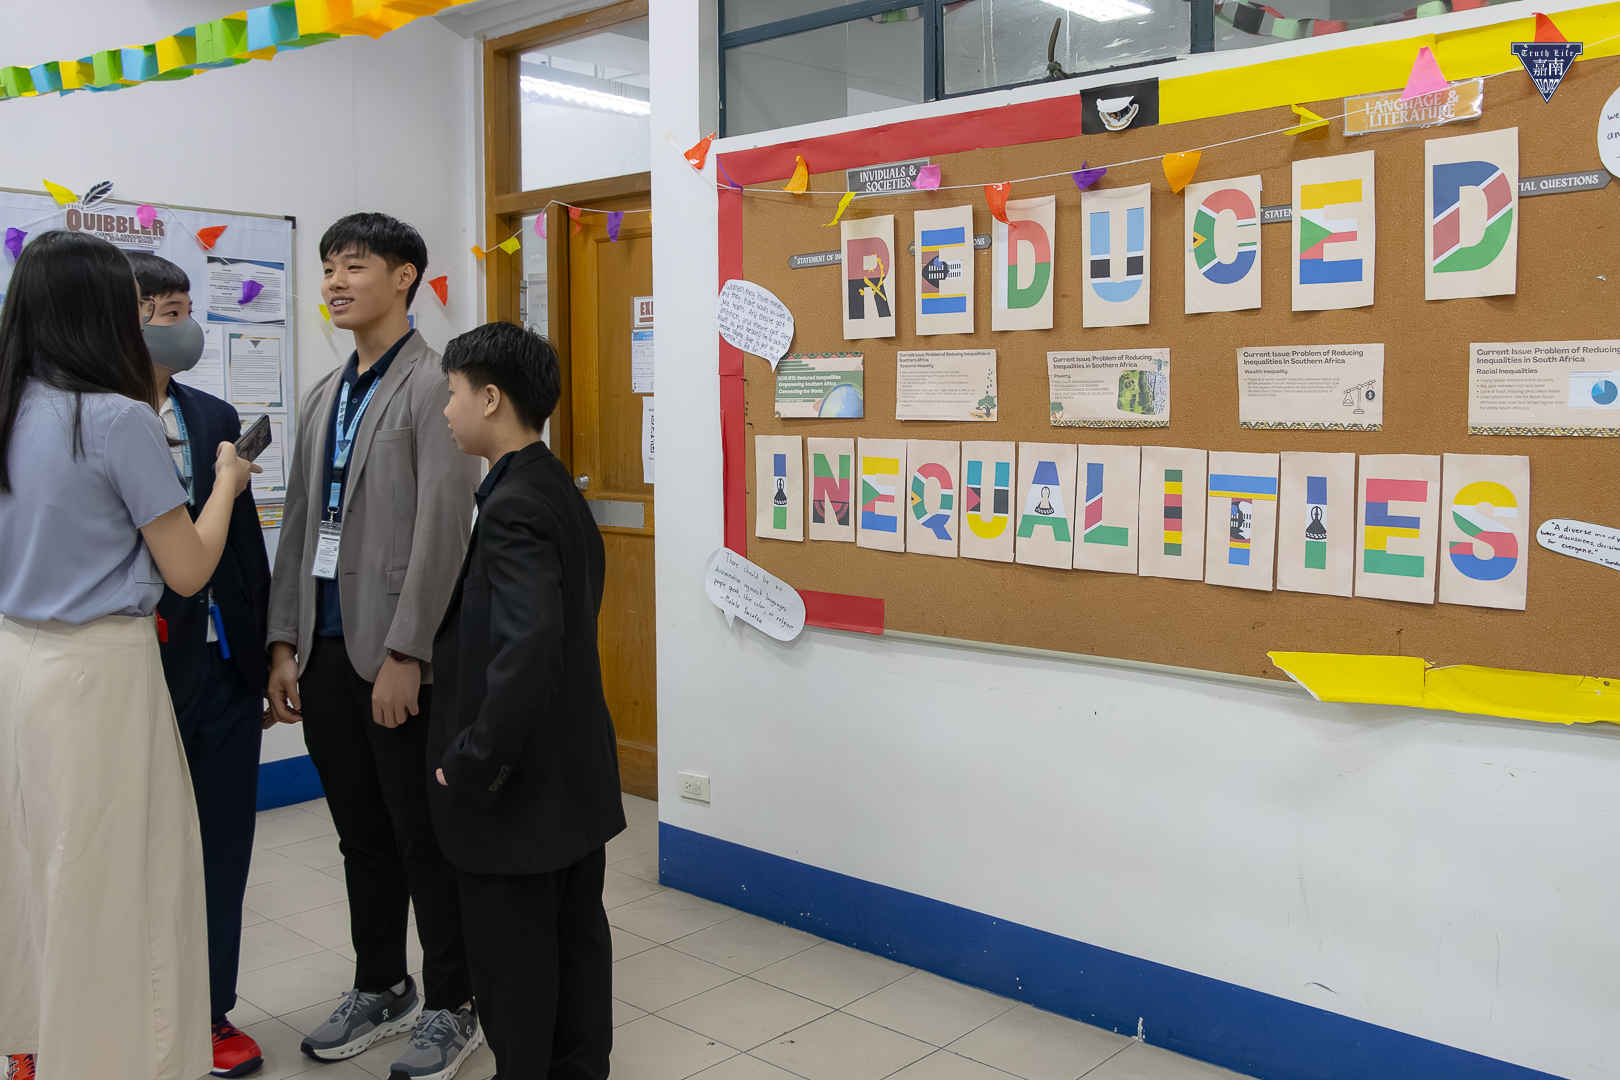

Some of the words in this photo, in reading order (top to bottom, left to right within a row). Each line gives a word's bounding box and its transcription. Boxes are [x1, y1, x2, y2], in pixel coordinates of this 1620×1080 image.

[1365, 92, 1442, 115] LANGUAGE
[1447, 90, 1459, 103] &
[1370, 103, 1455, 127] LITERATURE
[860, 167, 905, 183] INVIDUALS
[909, 165, 917, 176] &
[866, 177, 911, 192] SOCIETIES
[1540, 175, 1599, 190] QUESTIONS
[797, 255, 825, 264] STATEMENT
[1583, 346, 1620, 354] Reducing
[1477, 357, 1522, 365] Inequalities
[1564, 526, 1591, 535] diverse
[726, 552, 739, 568] There
[762, 575, 769, 584] be
